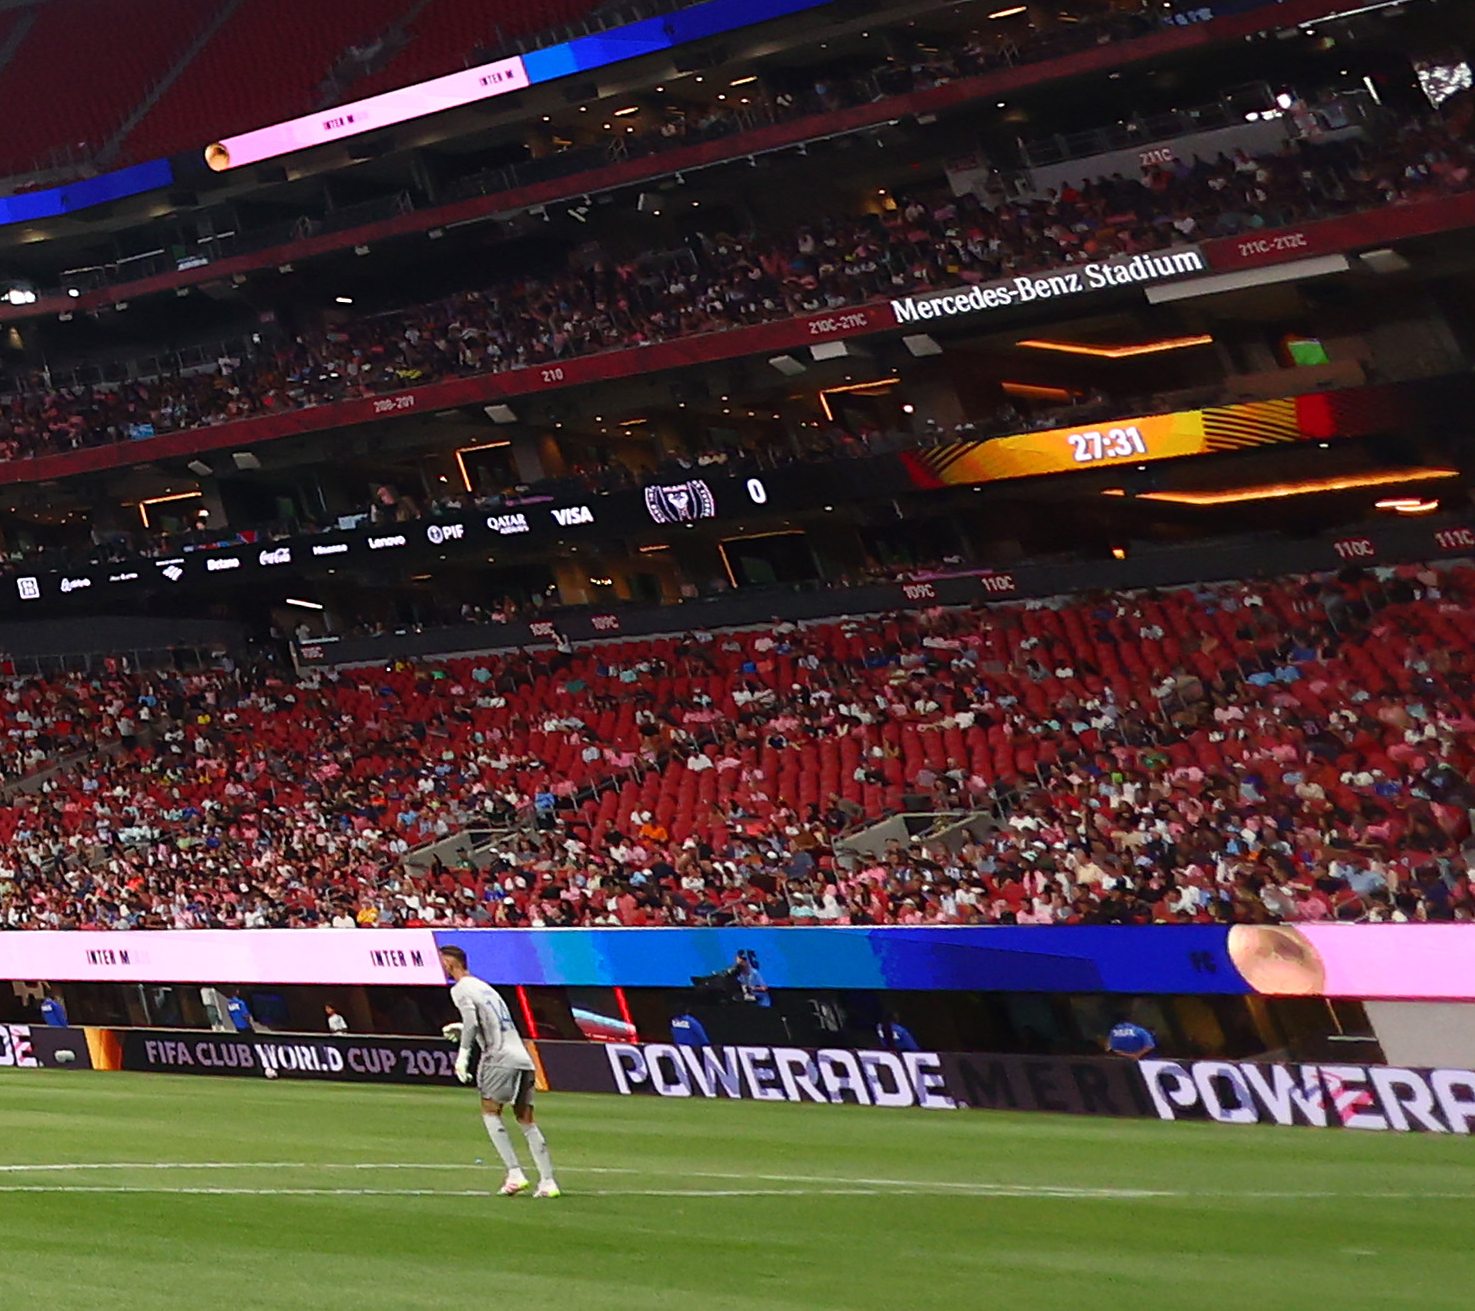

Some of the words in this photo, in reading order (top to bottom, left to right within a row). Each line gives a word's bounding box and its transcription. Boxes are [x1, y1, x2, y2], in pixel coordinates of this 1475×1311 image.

[891, 271, 1083, 323] Mercedes-Benz
[1085, 250, 1203, 289] Stadium
[541, 367, 565, 383] 210
[1068, 426, 1147, 462] 27:31
[747, 479, 766, 504] 0
[486, 513, 525, 531] QATAR
[550, 506, 593, 526] VISA
[442, 524, 464, 540] PIF
[368, 535, 406, 549] Lenovo
[86, 950, 116, 965] INTER
[370, 950, 407, 967] INTER
[144, 1039, 196, 1066] FIFA
[196, 1041, 254, 1069] CLUB
[255, 1043, 344, 1072] WORLD
[348, 1048, 397, 1075] CUP
[606, 1042, 967, 1111] POWERADE
